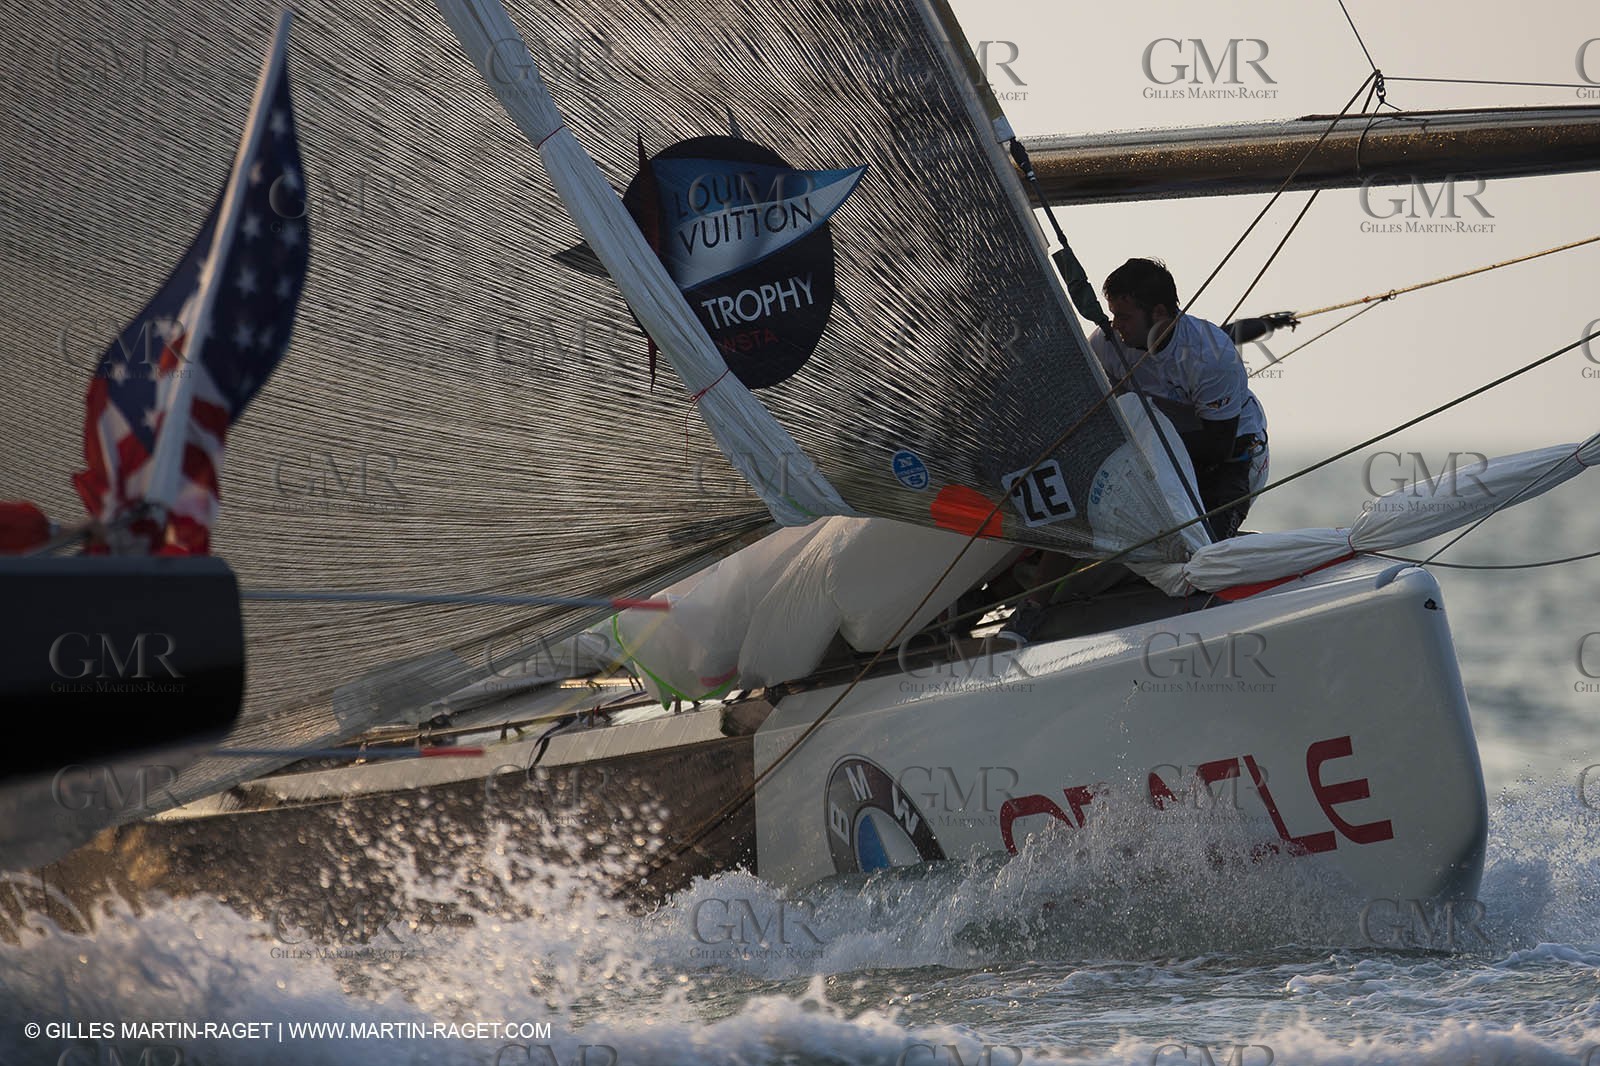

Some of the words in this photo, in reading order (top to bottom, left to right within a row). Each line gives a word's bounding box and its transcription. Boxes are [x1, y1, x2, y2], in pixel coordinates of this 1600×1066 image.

[679, 197, 813, 256] VUITTON
[701, 273, 814, 329] TROPHY
[1010, 466, 1071, 523] 2E
[830, 765, 919, 848] BMW
